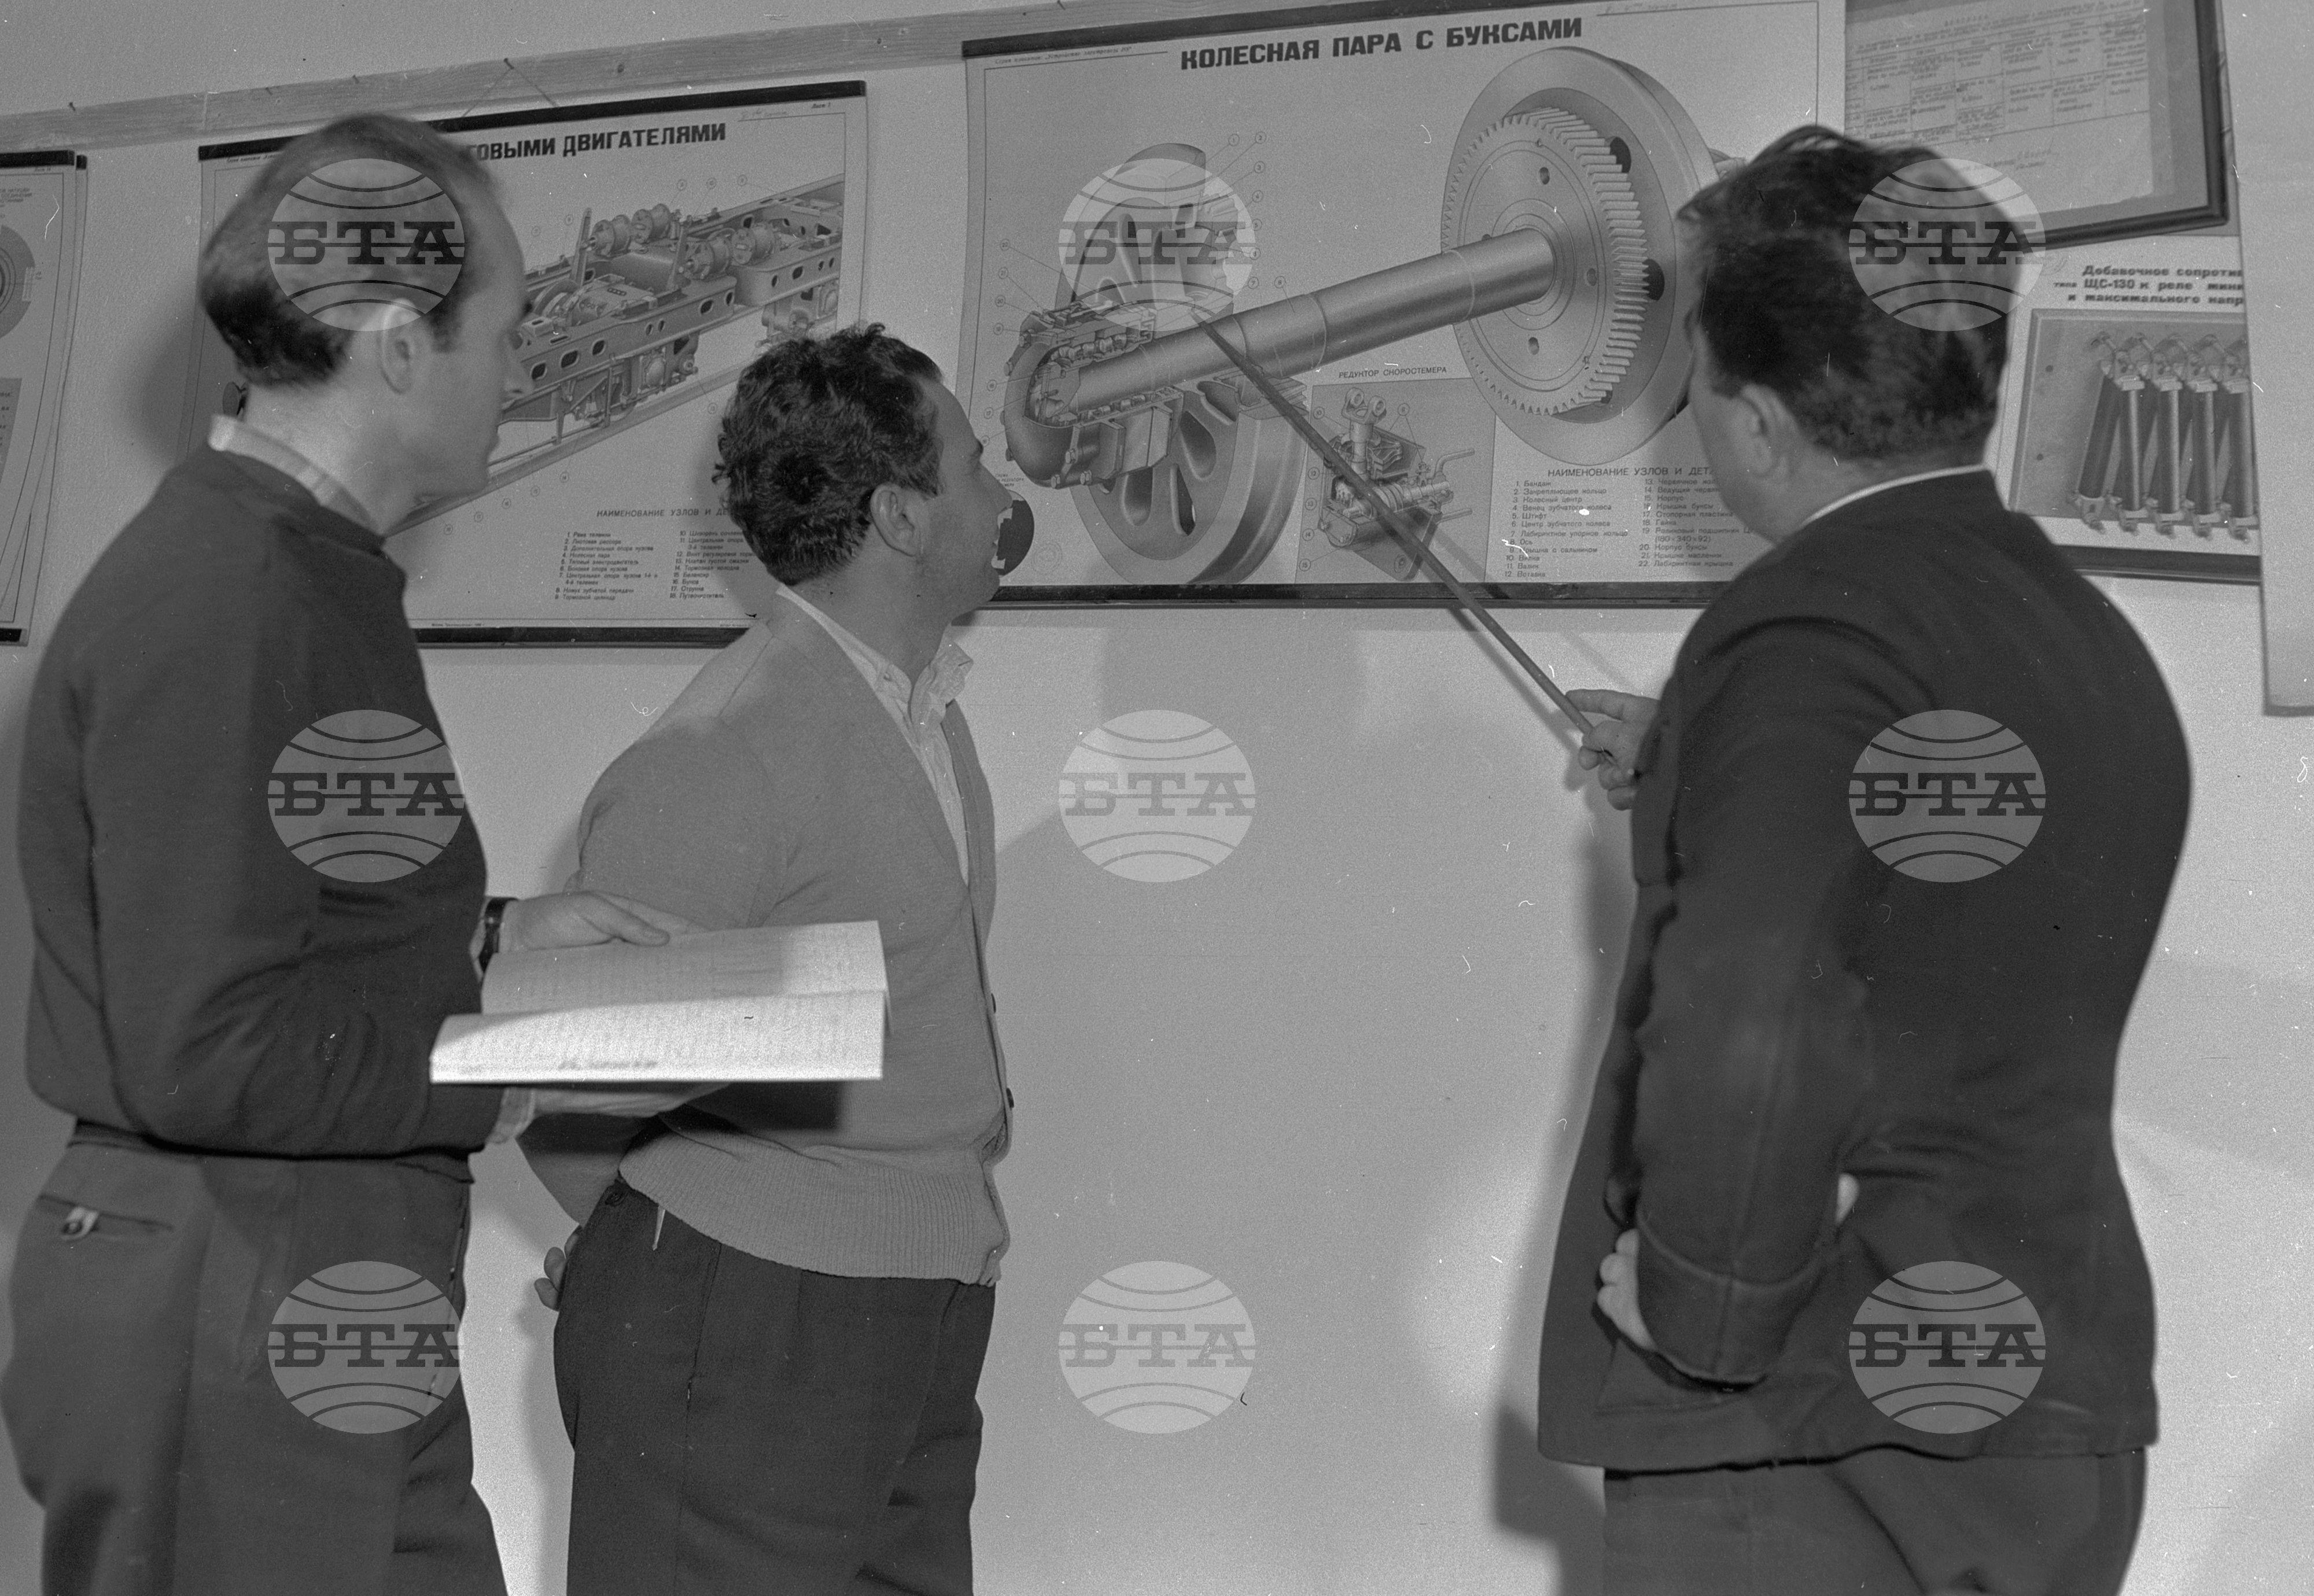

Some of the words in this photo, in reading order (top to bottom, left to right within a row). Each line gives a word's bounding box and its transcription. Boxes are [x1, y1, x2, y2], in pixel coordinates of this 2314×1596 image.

[1181, 39, 1320, 70] КОЛЕСНАЯ
[1332, 32, 1402, 57] ПАРА
[1416, 30, 1434, 50] С
[1446, 17, 1582, 47] БУКСАМИ
[563, 123, 726, 158] ДВИГАТЕЛЯМИ
[2083, 266, 2169, 277] Добавочное
[2084, 279, 2135, 289] ЩС-130
[2158, 282, 2193, 292] реле
[2085, 294, 2201, 304] максимального
[1339, 370, 1379, 378] РЕДУКТОР
[1383, 367, 1447, 376] СКОРОСТЕМЕРА
[1548, 468, 1628, 477] НАИМЕНОВАНИЕ
[1634, 467, 1668, 476] УЗЛОВ
[670, 508, 699, 517] УЗЛОВ
